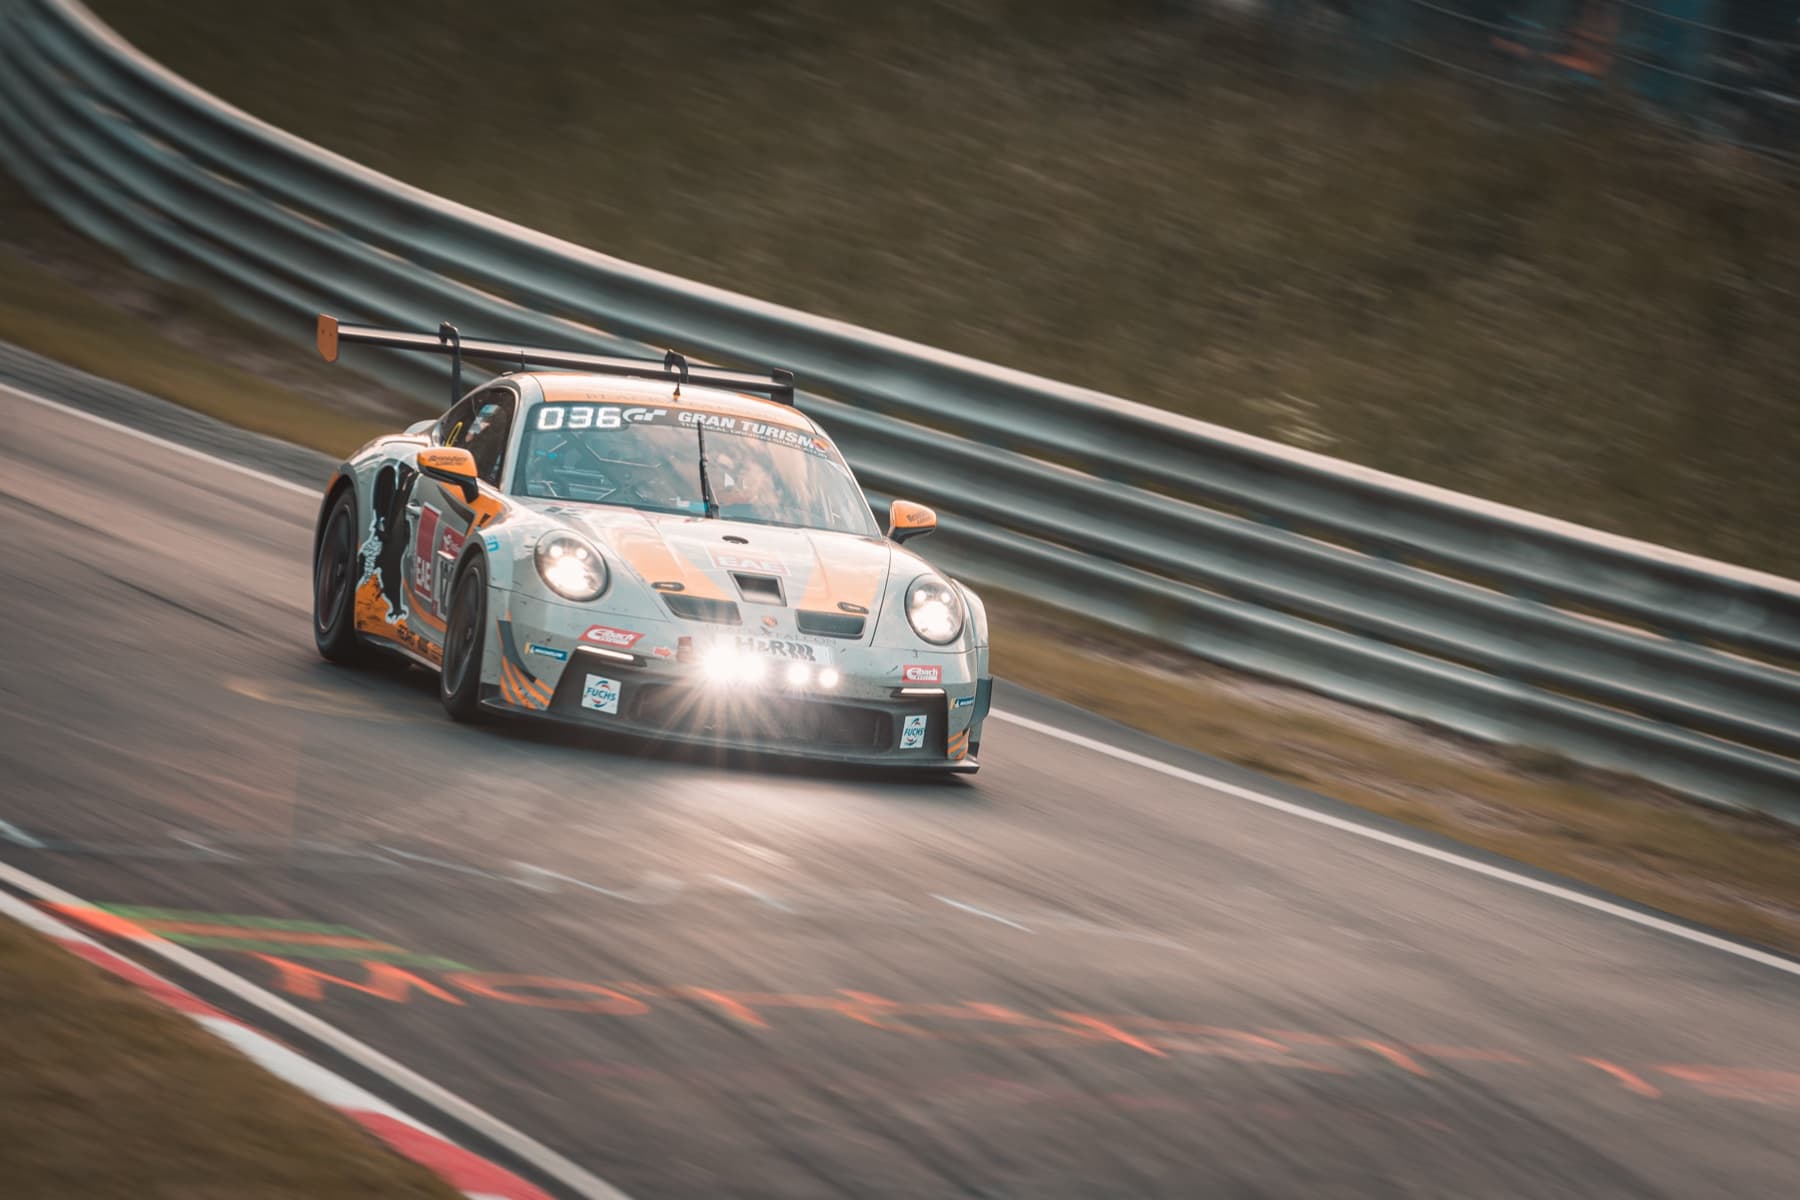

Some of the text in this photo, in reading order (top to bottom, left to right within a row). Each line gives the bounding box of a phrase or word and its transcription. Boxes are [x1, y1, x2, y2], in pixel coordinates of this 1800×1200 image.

[537, 406, 622, 431] 036
[678, 411, 736, 429] GRAN
[586, 688, 616, 701] FUCHS
[904, 728, 924, 737] FUCHS
